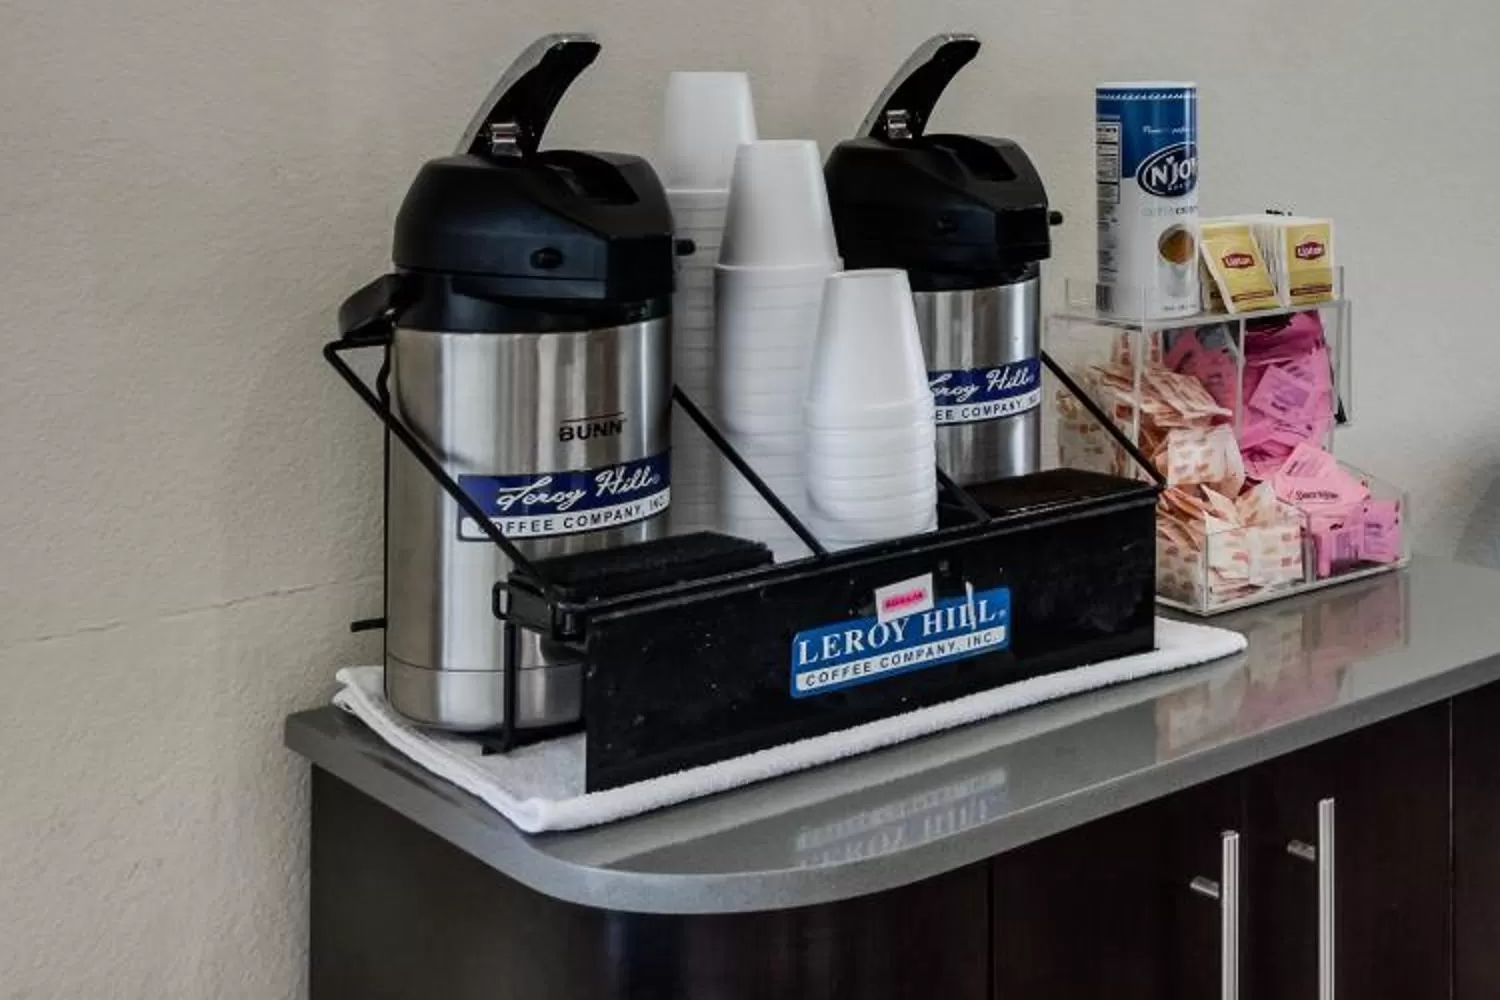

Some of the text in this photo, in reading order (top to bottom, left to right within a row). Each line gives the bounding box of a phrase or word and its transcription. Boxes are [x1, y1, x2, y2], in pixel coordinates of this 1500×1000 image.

[559, 420, 623, 442] BUNN
[478, 518, 554, 535] OFFEE
[799, 616, 911, 665] LEROY
[805, 660, 872, 688] COFFEE
